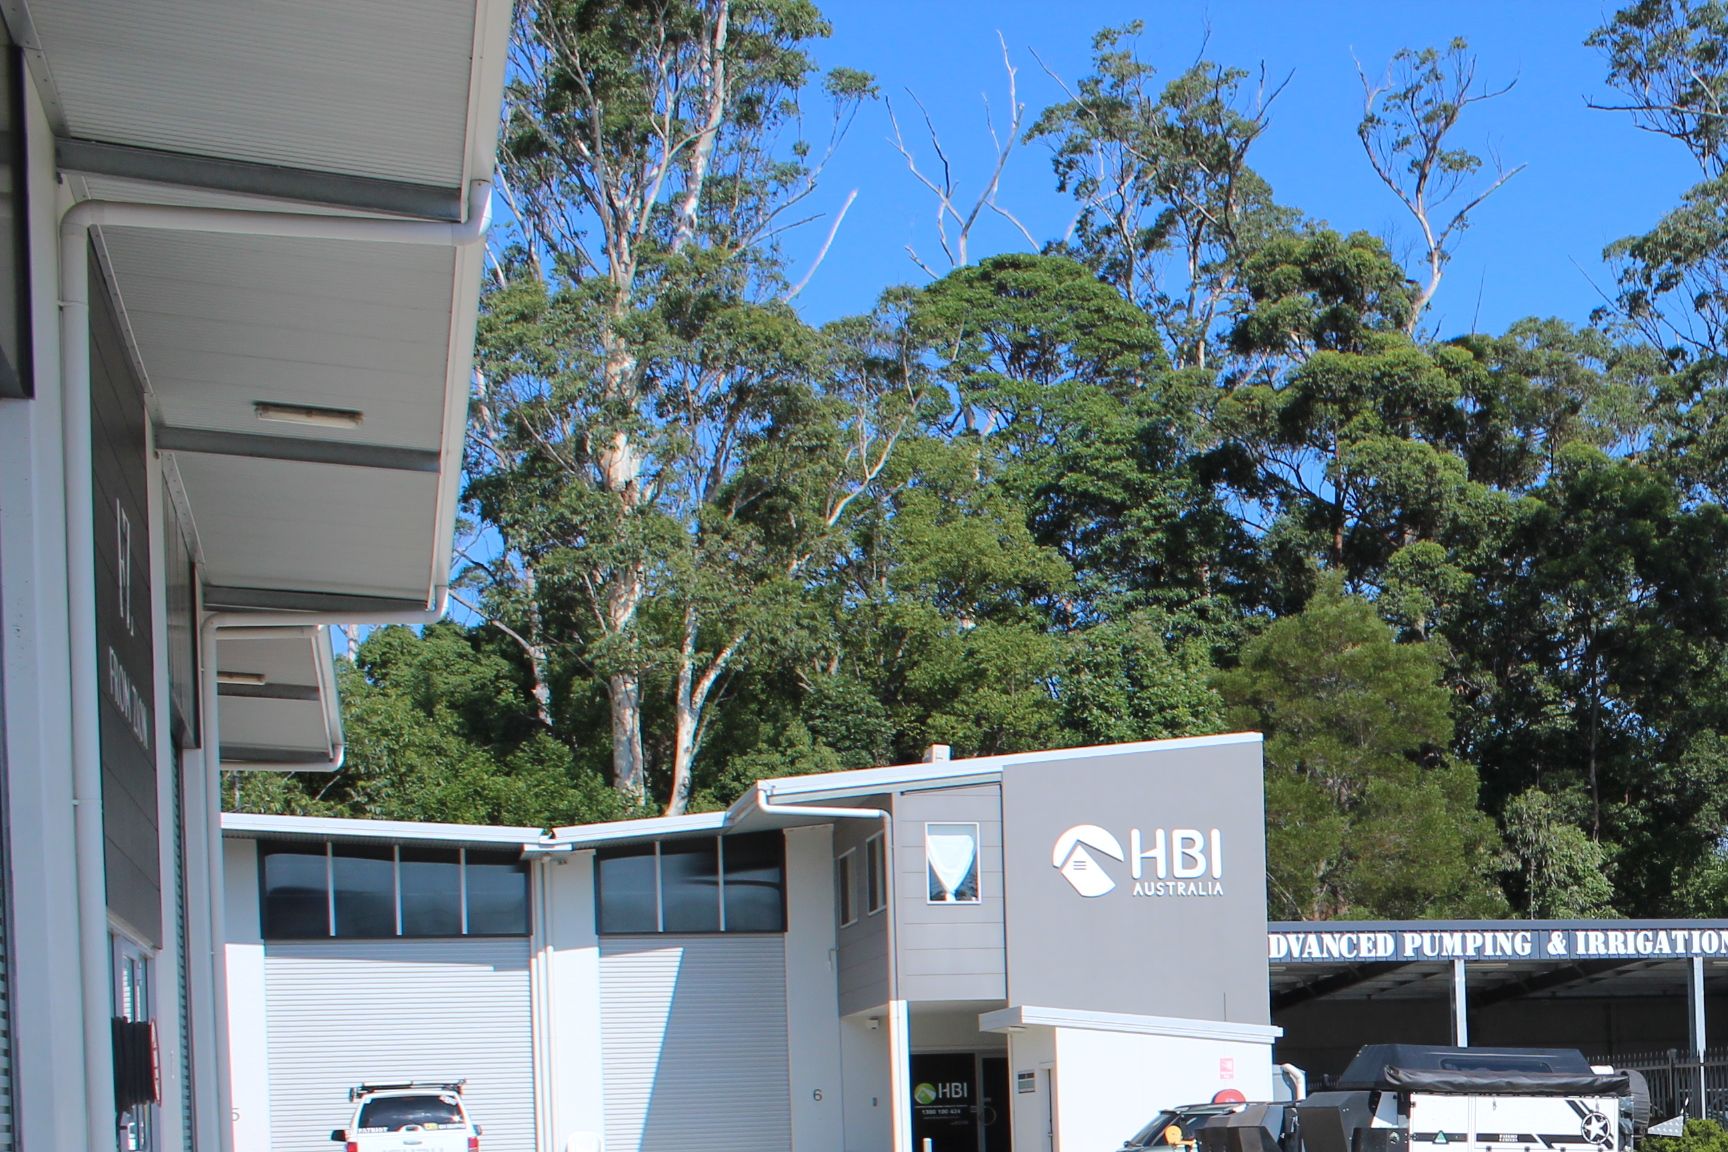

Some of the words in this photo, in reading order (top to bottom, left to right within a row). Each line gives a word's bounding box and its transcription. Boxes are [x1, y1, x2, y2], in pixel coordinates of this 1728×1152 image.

[1131, 828, 1222, 879] HBI
[1133, 881, 1223, 896] AUSTRALIA
[1268, 933, 1395, 958] DVANCED
[1403, 931, 1532, 957] PUMPING
[1546, 932, 1568, 955] &
[813, 1088, 823, 1102] 6
[938, 1082, 968, 1098] HBI
